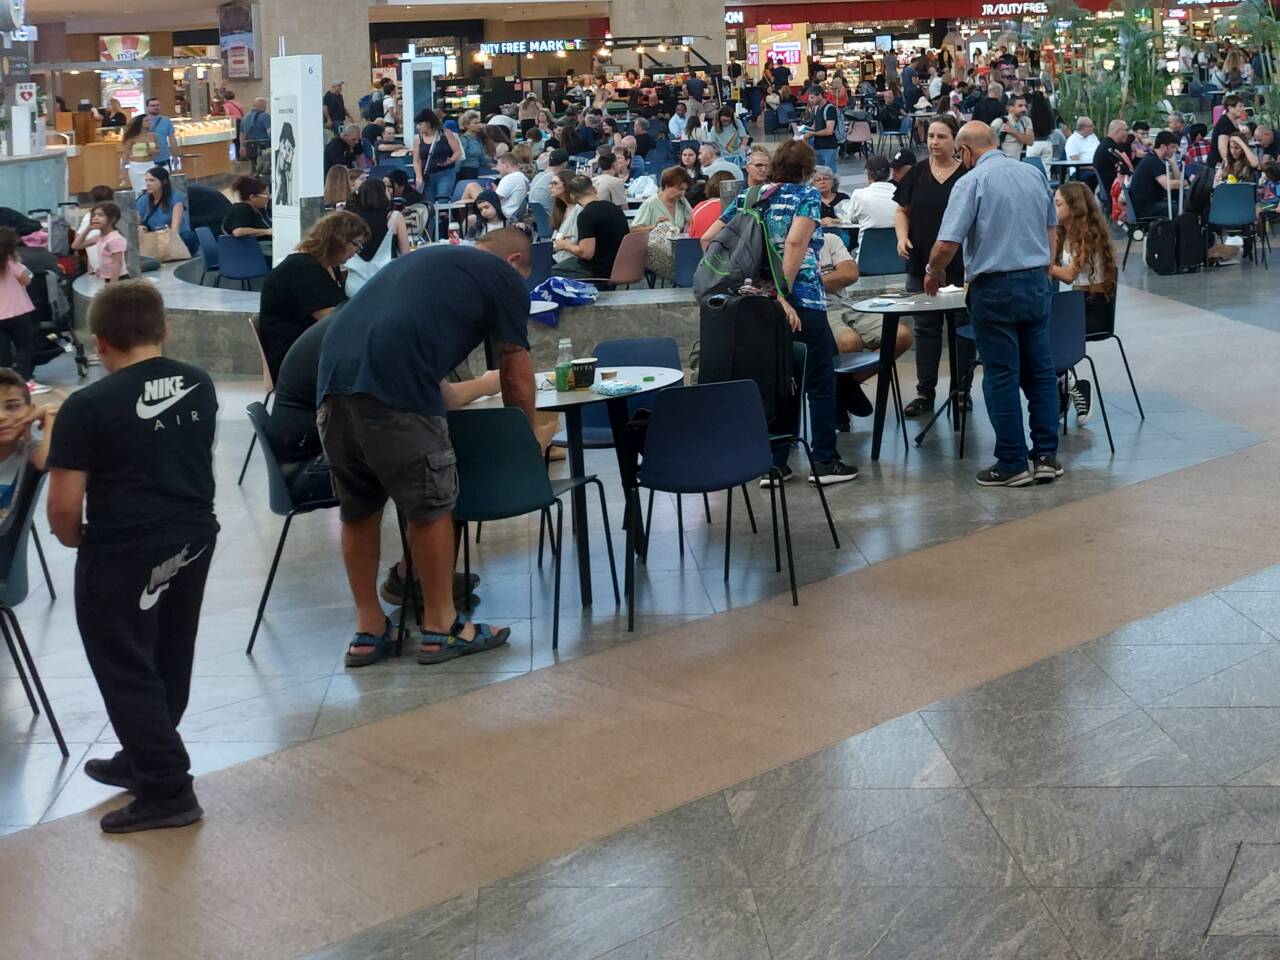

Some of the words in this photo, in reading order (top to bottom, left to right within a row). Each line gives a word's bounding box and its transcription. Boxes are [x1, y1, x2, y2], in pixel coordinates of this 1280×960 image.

[724, 11, 744, 24] ON
[480, 43, 500, 55] DUTY
[501, 41, 527, 54] FREE
[144, 375, 185, 402] NIKE
[154, 410, 200, 431] AIR
